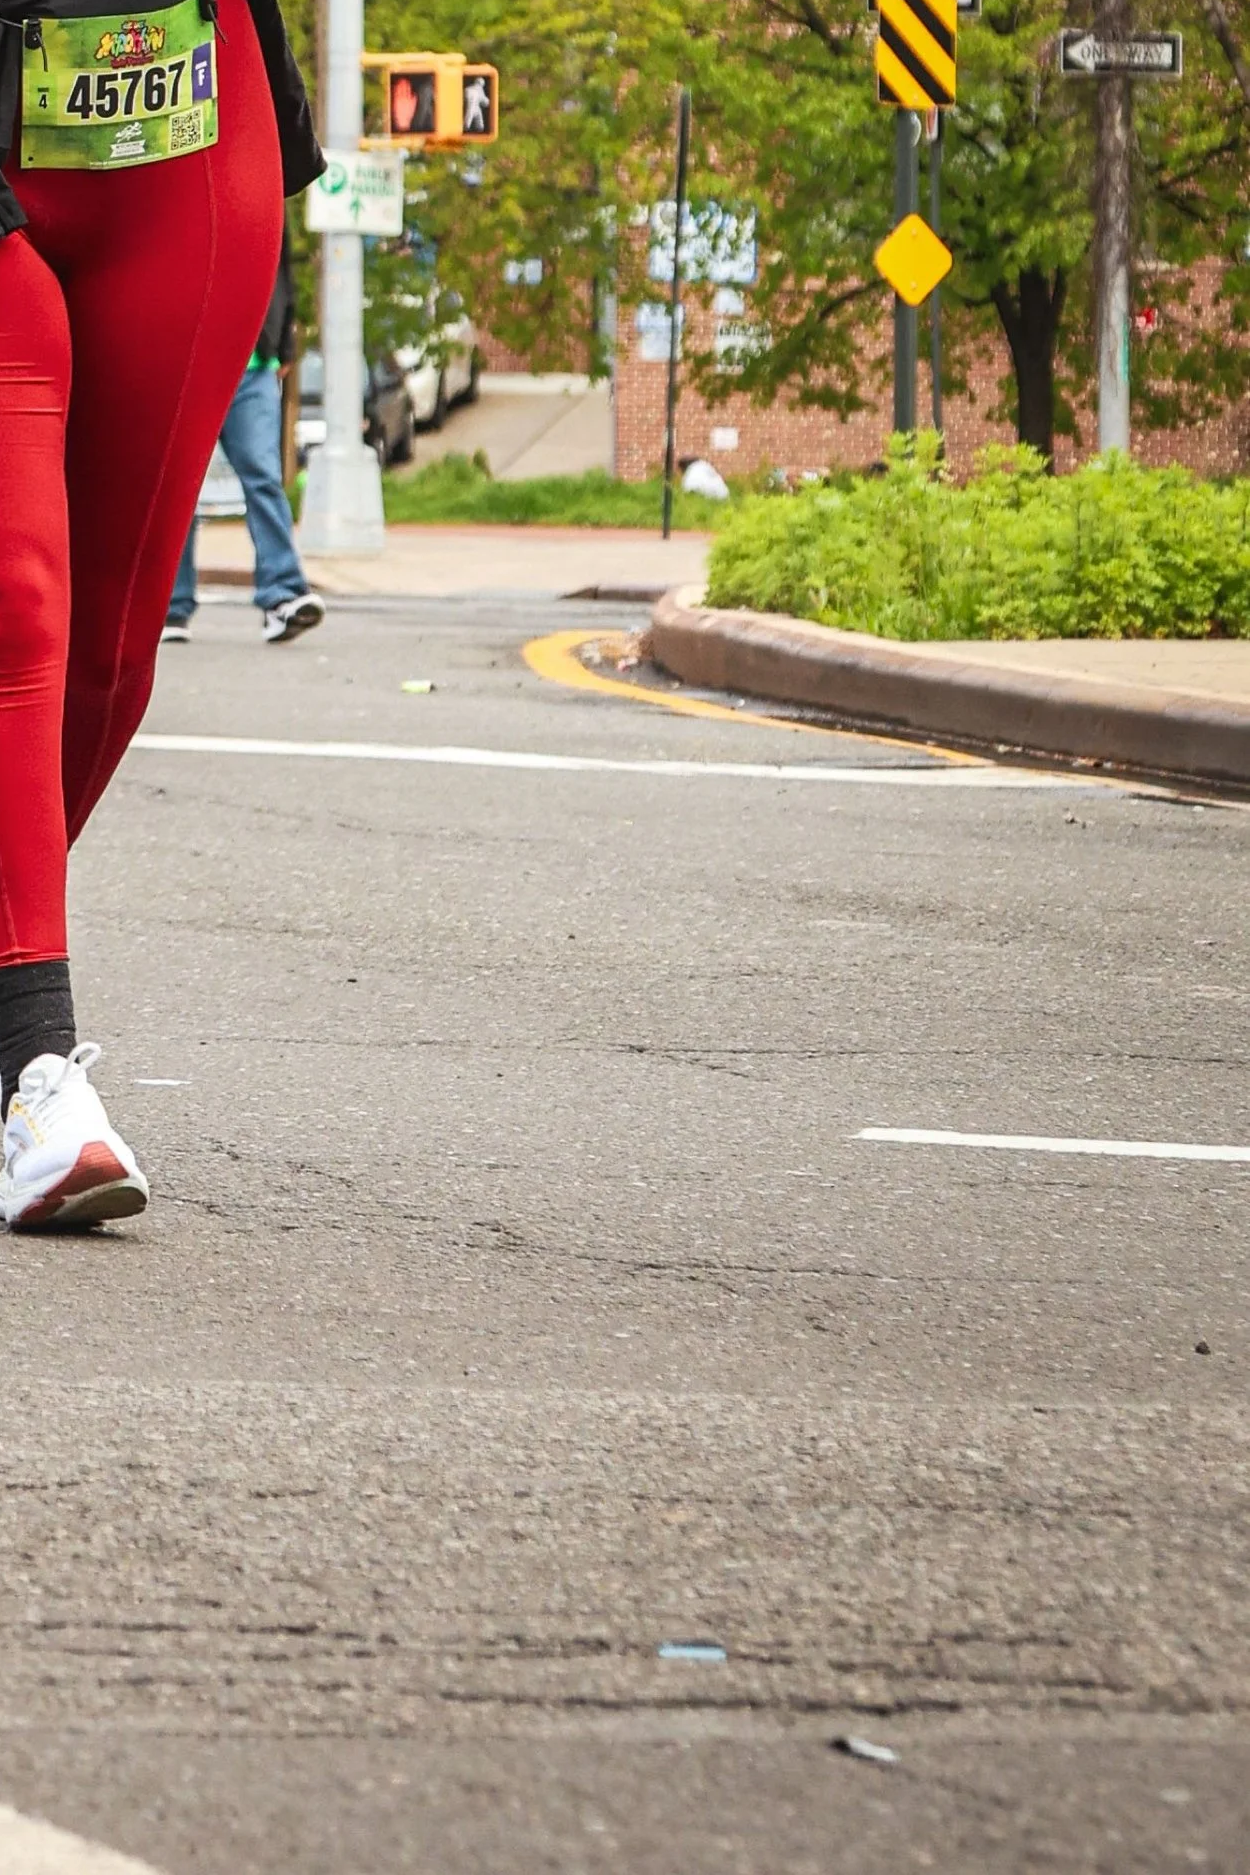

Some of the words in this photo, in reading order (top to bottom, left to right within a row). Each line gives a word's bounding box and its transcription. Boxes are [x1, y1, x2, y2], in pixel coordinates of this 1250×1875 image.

[197, 68, 206, 87] F
[66, 60, 186, 120] 45767
[38, 93, 48, 109] 4
